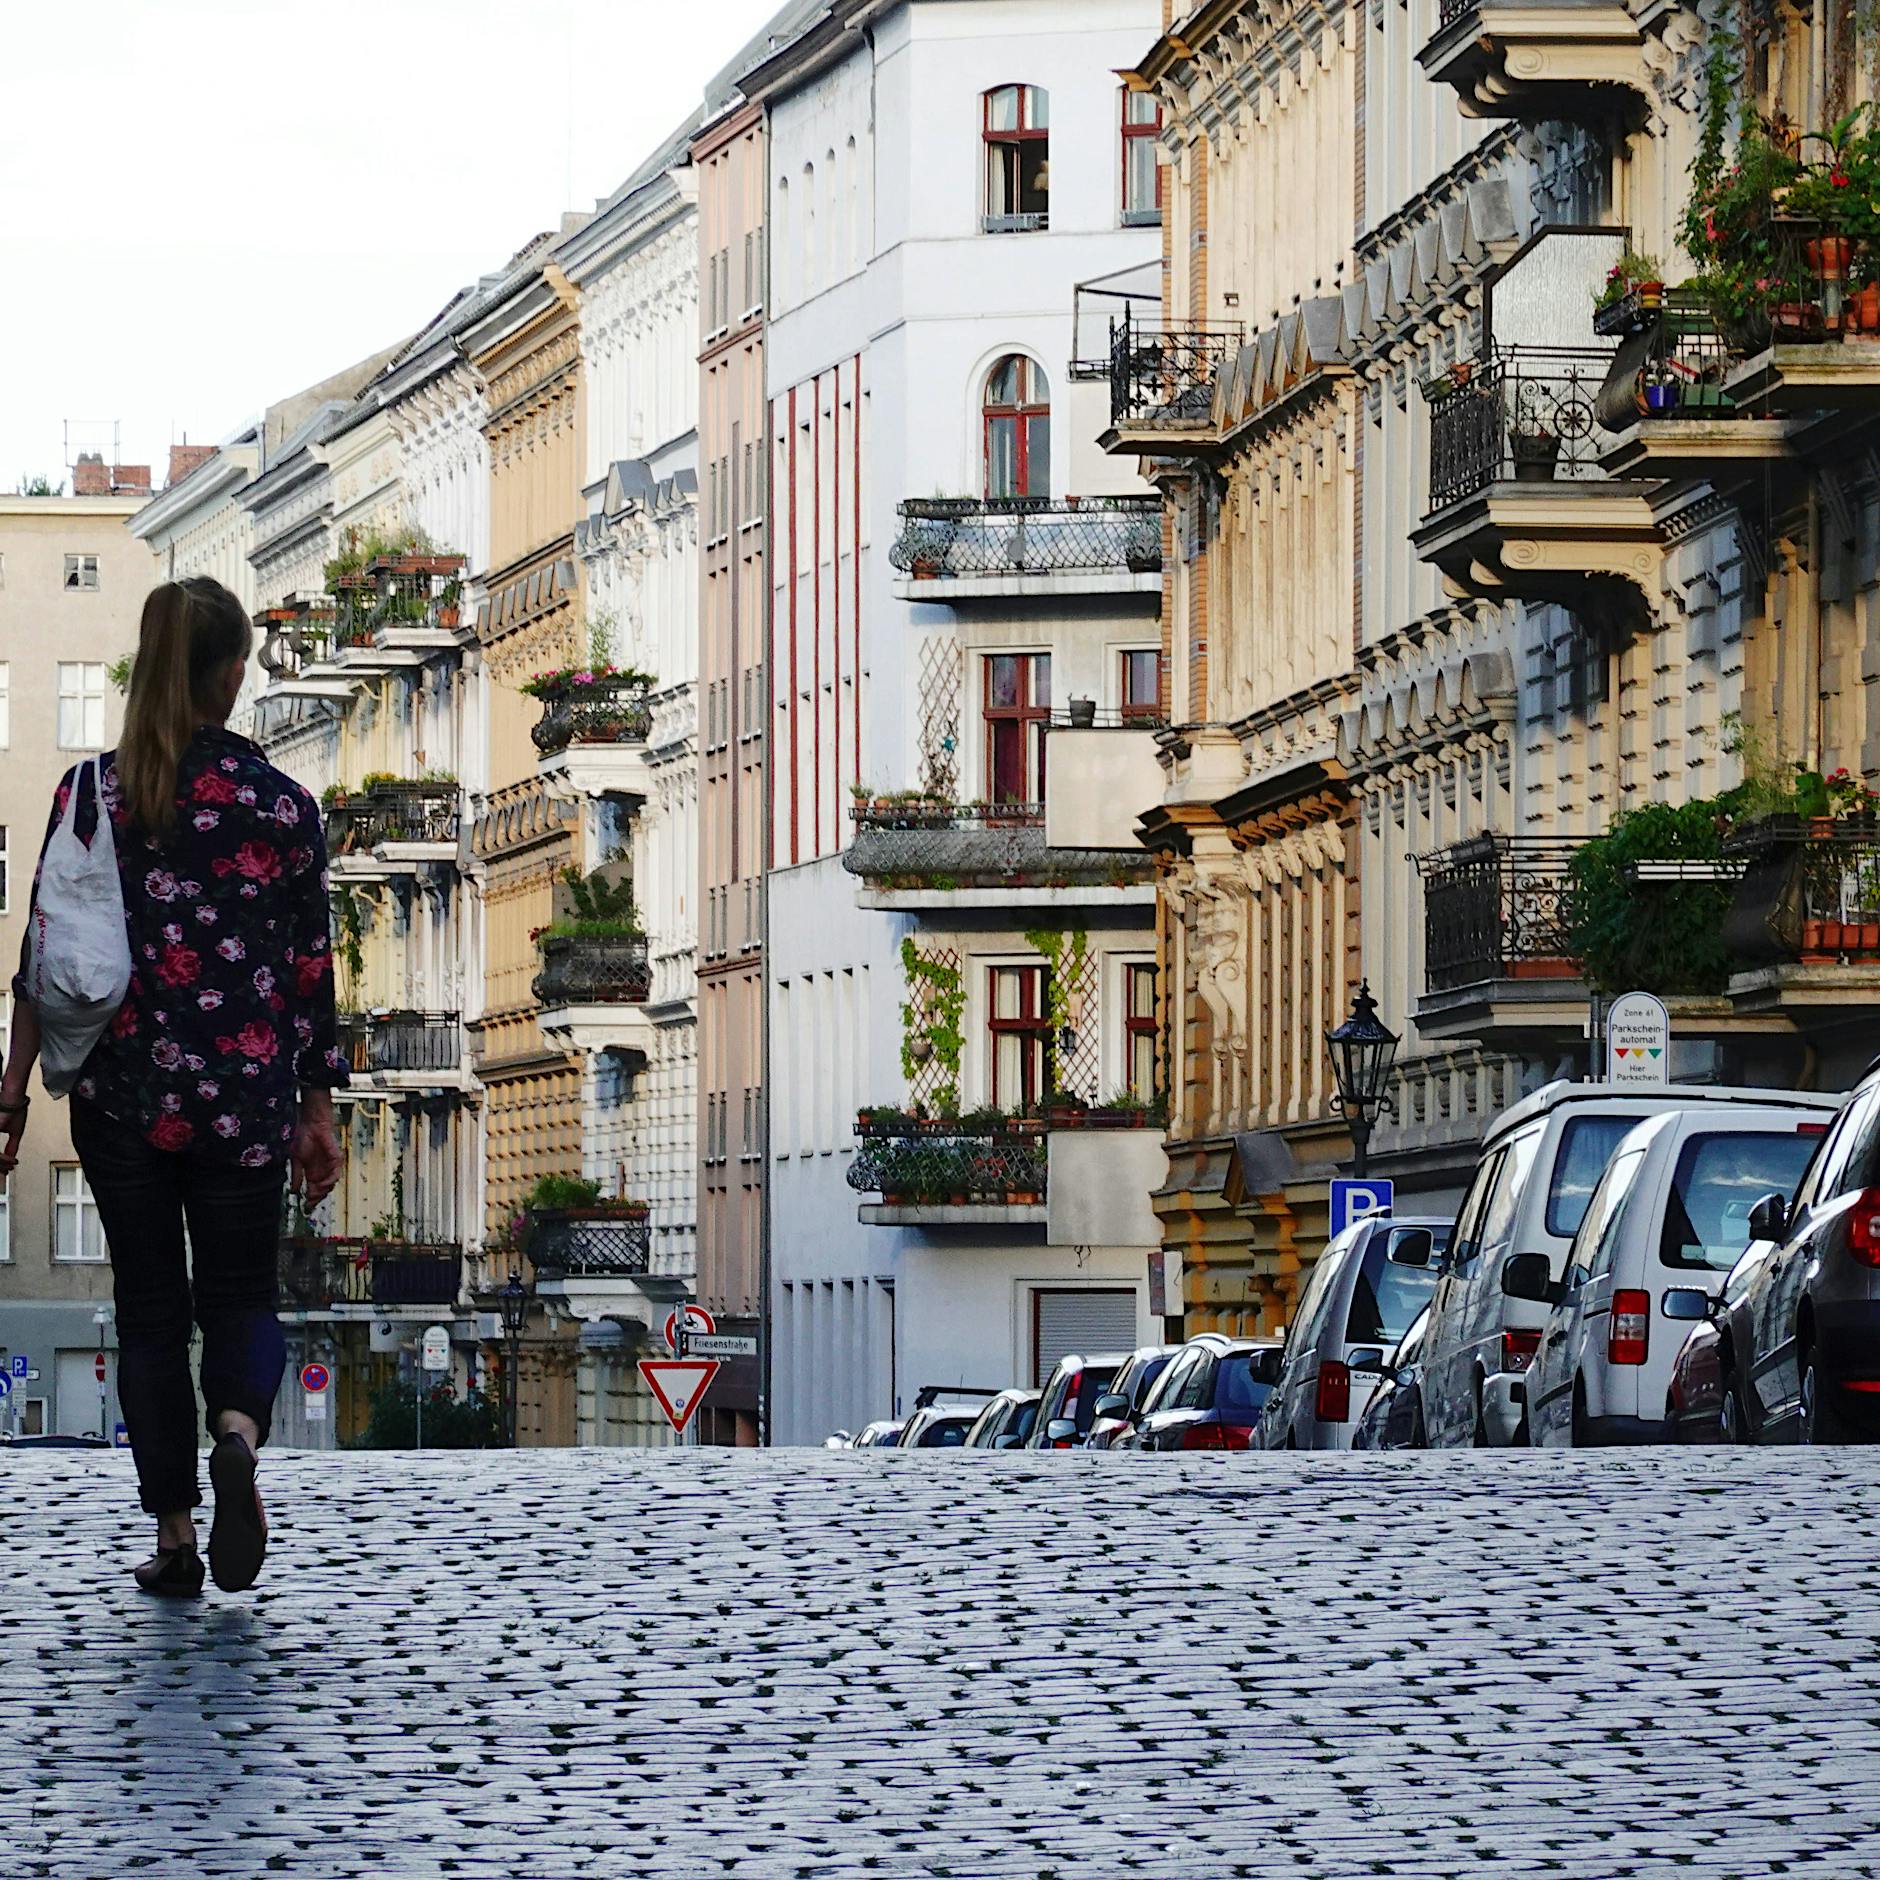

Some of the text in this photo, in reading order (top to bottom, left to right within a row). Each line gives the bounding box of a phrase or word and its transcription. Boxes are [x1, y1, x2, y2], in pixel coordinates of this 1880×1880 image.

[1624, 1009, 1643, 1017] Zone
[1612, 1024, 1665, 1033] Parkschein-
[1620, 1035, 1657, 1044] automat
[1630, 1063, 1646, 1072] Hier
[1616, 1073, 1660, 1081] Parkschein
[1345, 1187, 1378, 1229] P
[694, 1337, 749, 1352] Friesenstraße
[14, 1358, 24, 1375] P
